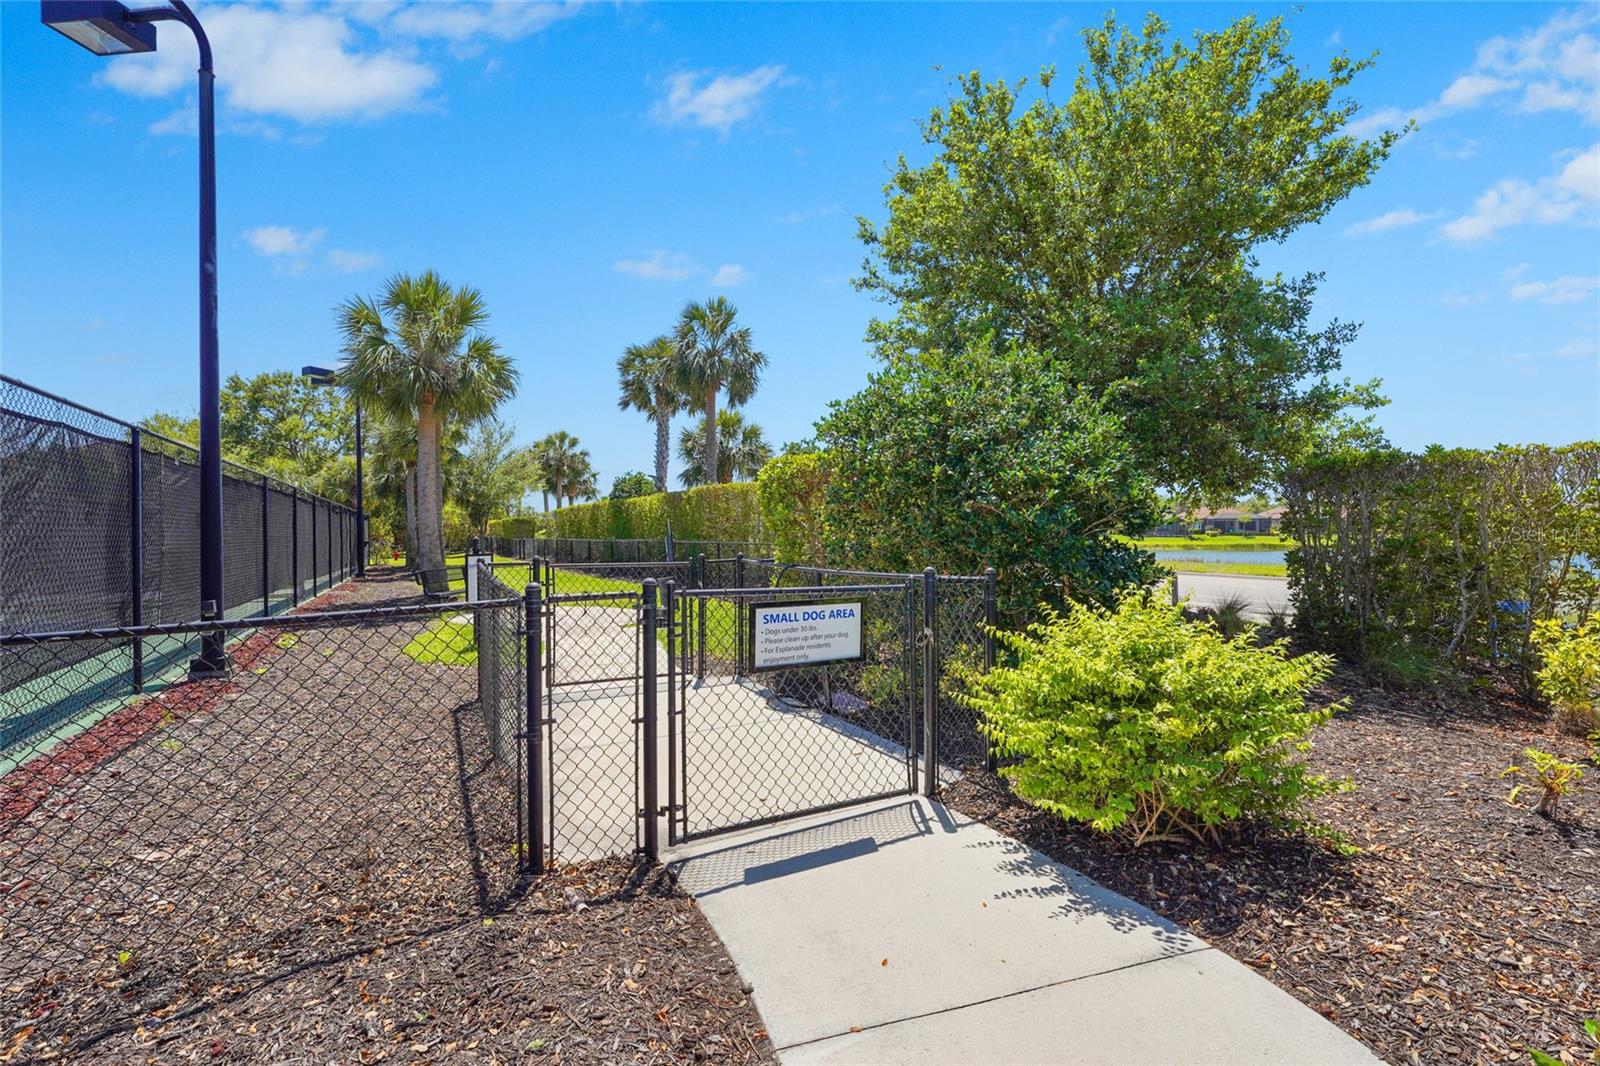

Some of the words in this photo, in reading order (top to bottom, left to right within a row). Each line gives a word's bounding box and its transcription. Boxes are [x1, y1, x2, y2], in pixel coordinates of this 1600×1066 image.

[763, 612, 799, 624] SMALL
[802, 610, 826, 621] DOG
[828, 608, 856, 619] AREA
[764, 627, 781, 636] Dogs
[781, 626, 799, 634] under
[764, 636, 784, 644] Please
[784, 635, 800, 643] clean
[810, 633, 823, 641] after
[823, 632, 837, 640] your
[775, 645, 806, 654] Esplanade
[806, 642, 832, 650] residents
[763, 655, 796, 664] enjoyment
